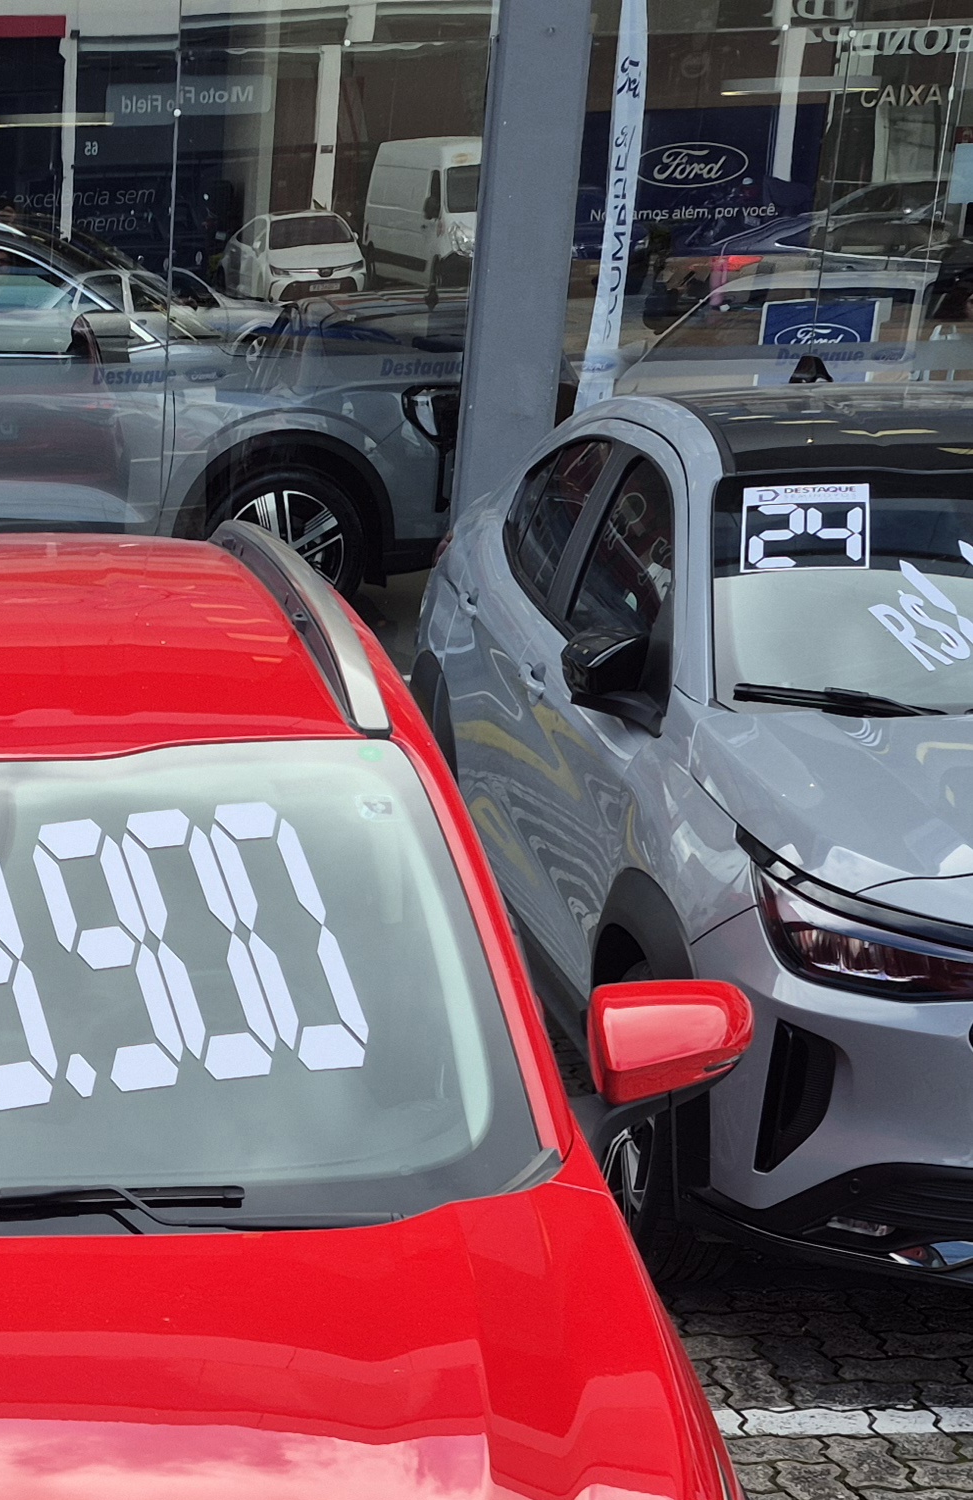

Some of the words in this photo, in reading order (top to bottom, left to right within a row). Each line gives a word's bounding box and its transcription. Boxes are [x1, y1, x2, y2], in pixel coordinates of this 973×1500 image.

[860, 84, 943, 108] CAIXA
[653, 148, 726, 180] Ford
[116, 188, 156, 206] sem
[672, 206, 711, 221] além,
[715, 207, 739, 222] por
[743, 203, 778, 217] você.
[93, 367, 176, 388] Destaque
[784, 486, 856, 494] DESTAQUE
[748, 504, 863, 569] 24
